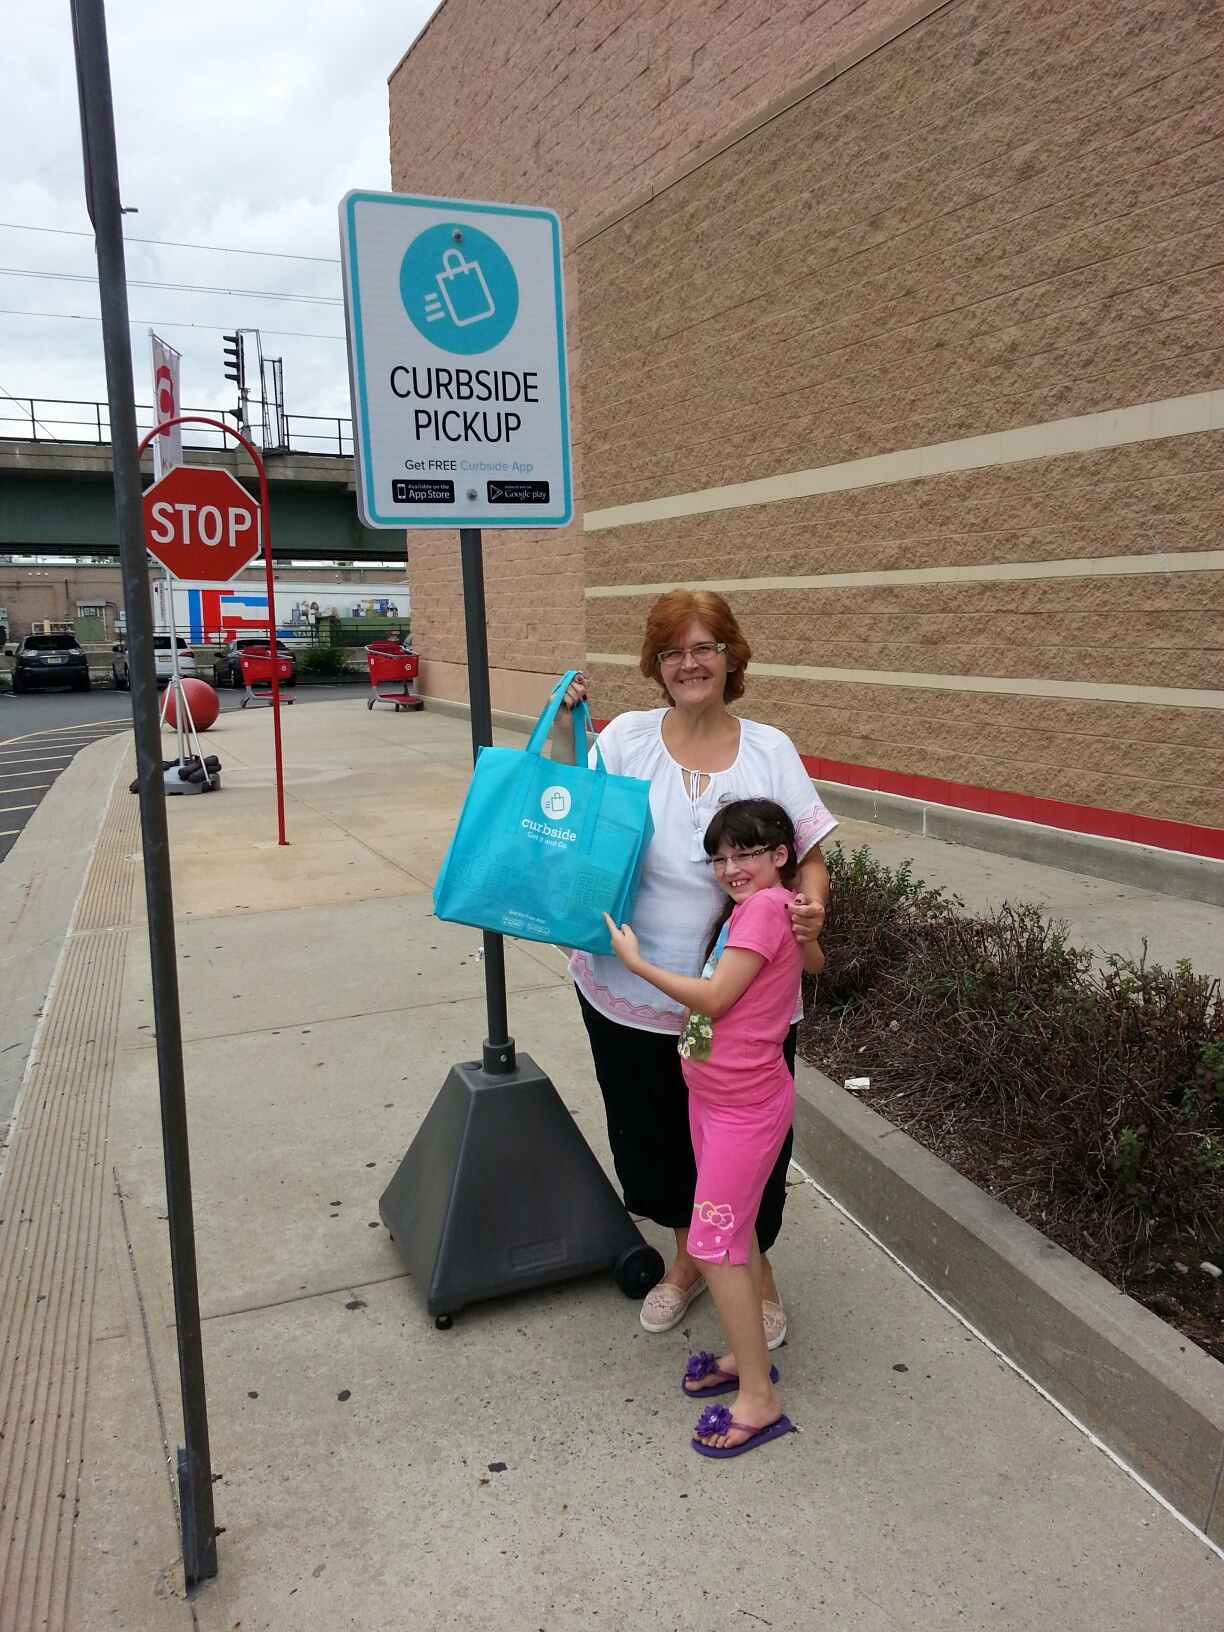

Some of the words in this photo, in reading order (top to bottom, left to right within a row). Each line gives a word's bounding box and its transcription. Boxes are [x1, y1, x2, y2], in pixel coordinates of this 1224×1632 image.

[390, 366, 539, 403] CURBSIDE
[414, 409, 521, 443] PICKUP
[405, 459, 426, 471] Get
[428, 460, 458, 471] FREE
[460, 460, 509, 472] Curbside
[512, 461, 534, 474] App
[409, 490, 427, 501] App
[427, 490, 450, 499] Store
[504, 489, 531, 501] Google
[532, 490, 547, 500] play
[150, 501, 252, 548] STOP
[521, 818, 577, 842] curbside
[527, 831, 539, 841] Get
[544, 838, 557, 847] and
[557, 841, 568, 849] Go
